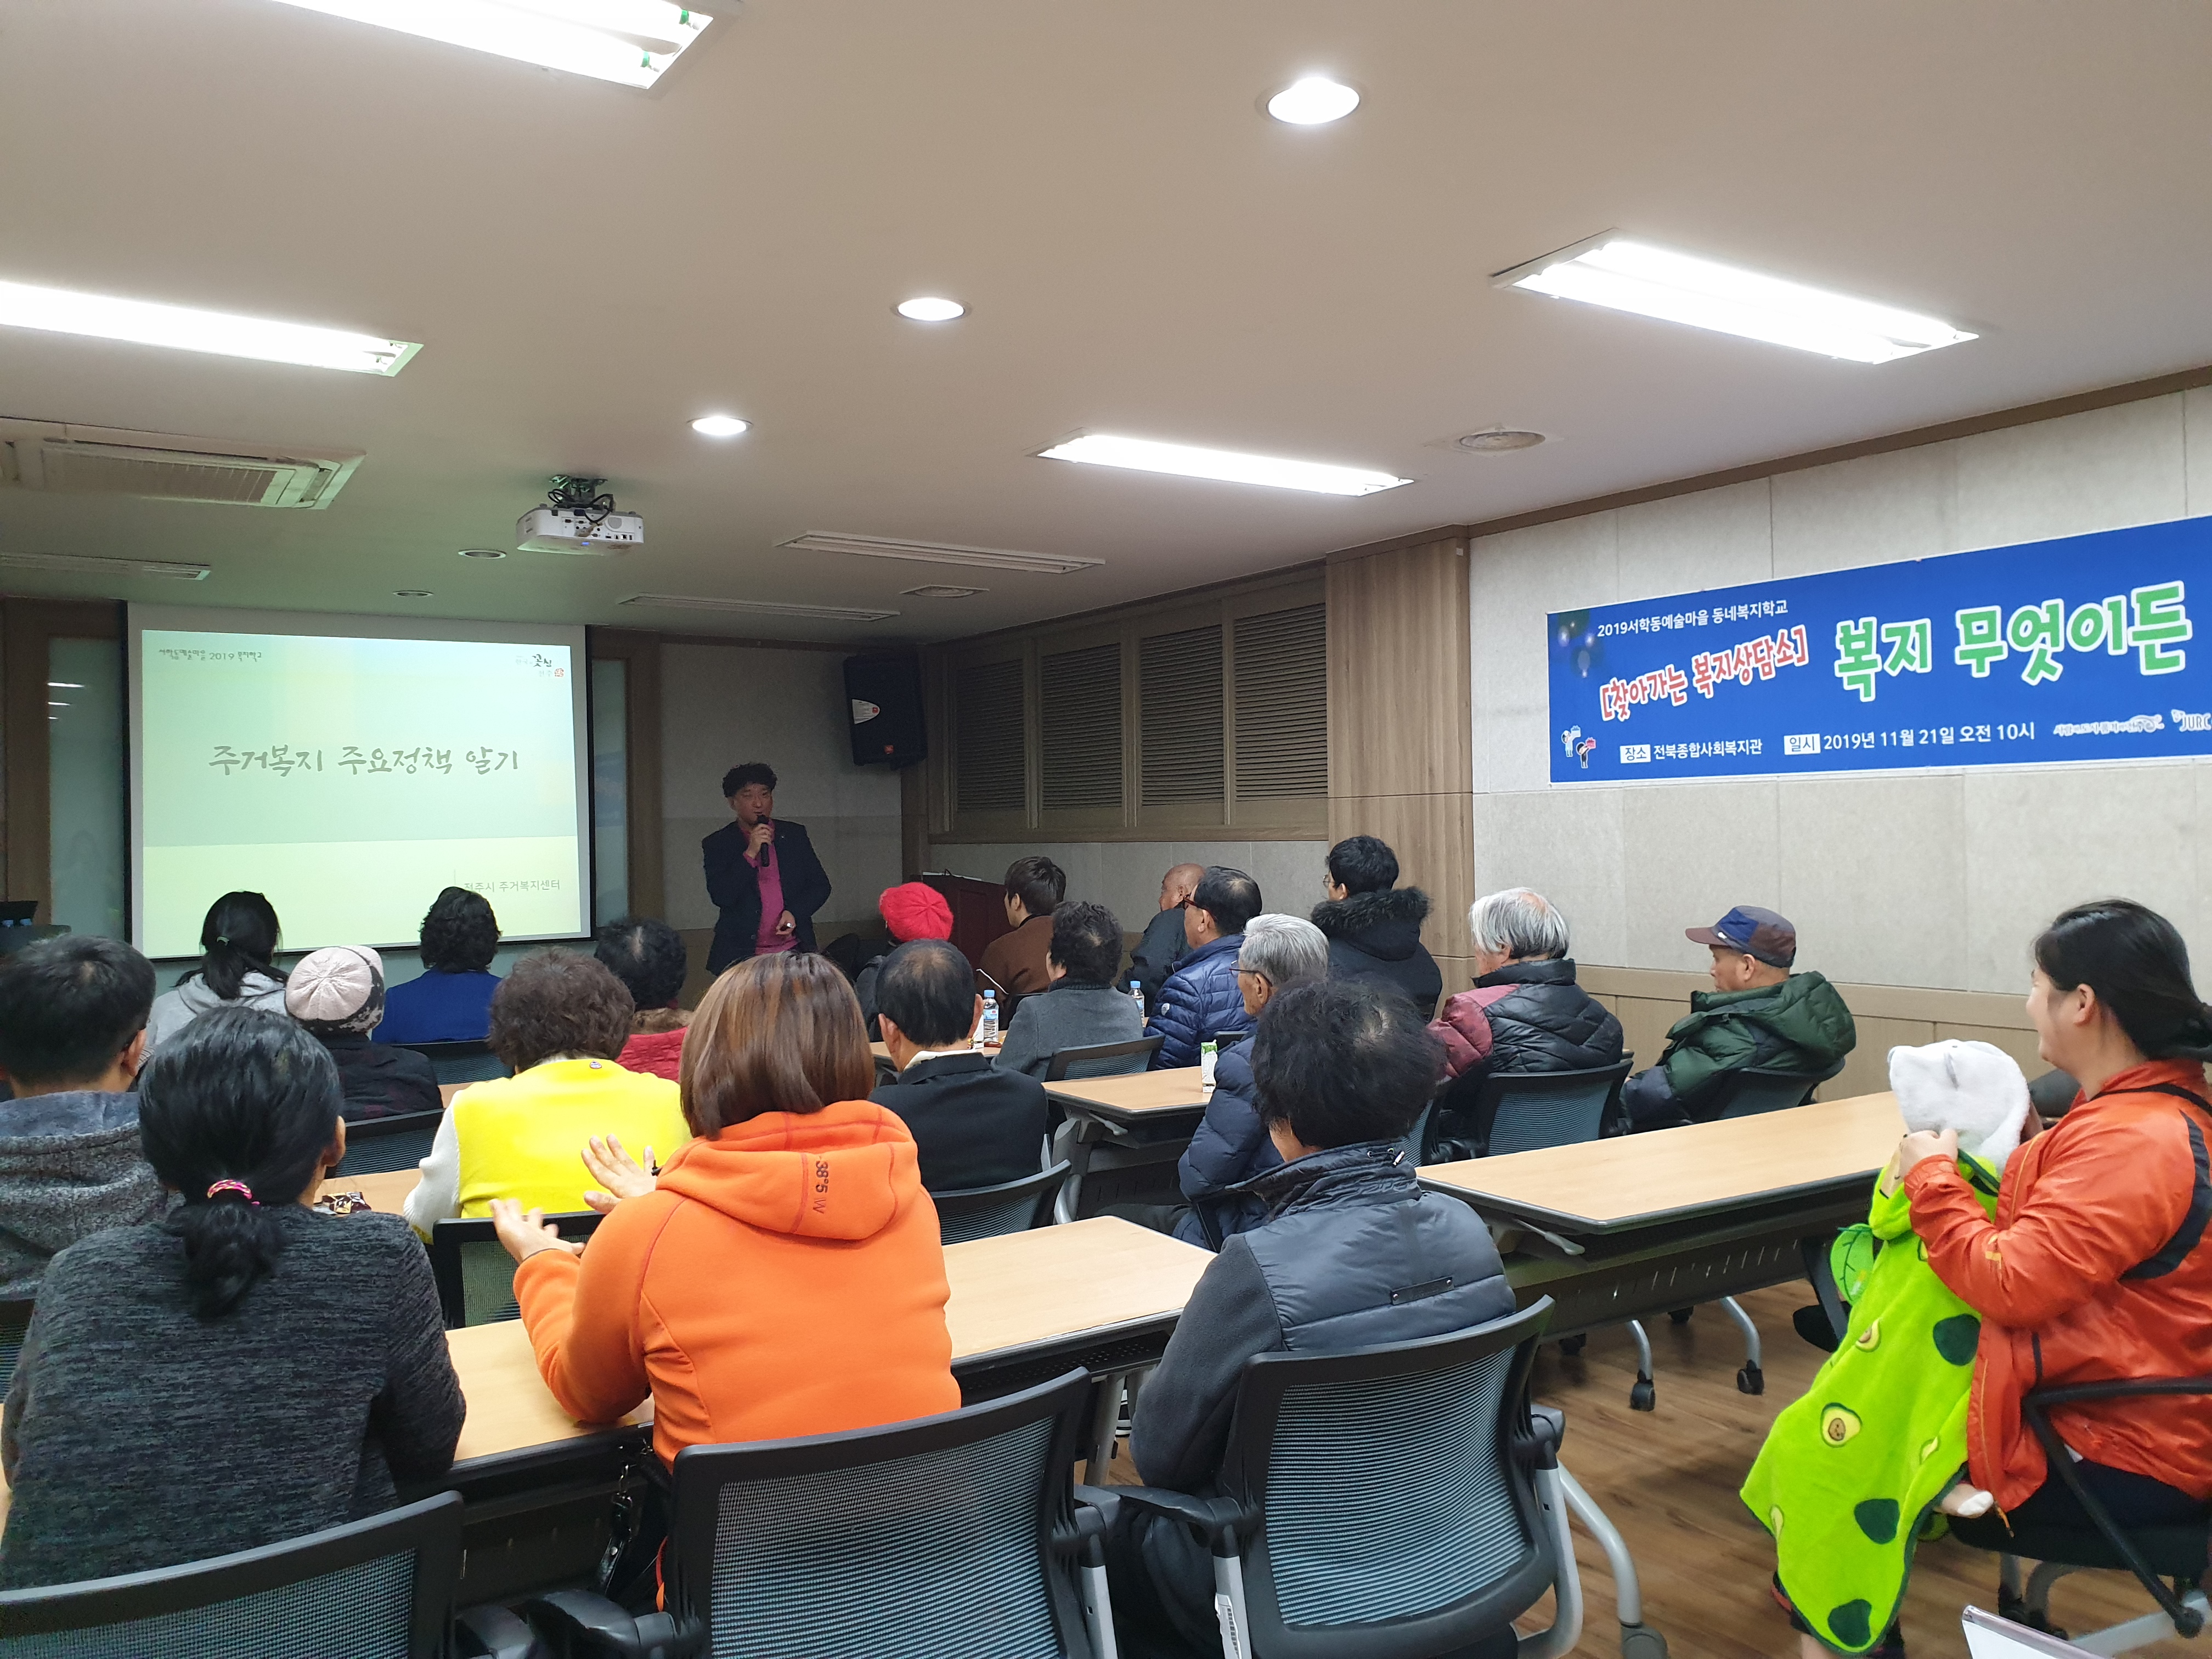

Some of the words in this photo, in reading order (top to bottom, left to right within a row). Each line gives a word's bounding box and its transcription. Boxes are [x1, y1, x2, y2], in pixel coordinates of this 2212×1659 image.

[1597, 610, 1709, 637] 2019서학동예술마을
[1712, 599, 1788, 624] 동네복지학교
[208, 652, 235, 661] 2019
[237, 651, 262, 663] 복지학교
[1835, 616, 1932, 702] 복지
[1955, 580, 2192, 686] 무엇이든
[1599, 663, 1688, 722] [찾아가는
[1691, 624, 1809, 699] 복지상담소]
[1625, 747, 1648, 761] 장소
[1654, 738, 1763, 760] 전북종합사회복지관
[1789, 736, 1815, 752] 일시
[1824, 731, 1875, 749] 2019년
[1880, 729, 1914, 746] 11월
[1918, 726, 1955, 744] 21일
[1959, 725, 1991, 743] 오전
[1996, 721, 2035, 740] 10시
[208, 744, 324, 777] 주거복지
[337, 746, 454, 775] 주요정책
[465, 746, 519, 775] 알기
[499, 879, 560, 892] 주거복지센터
